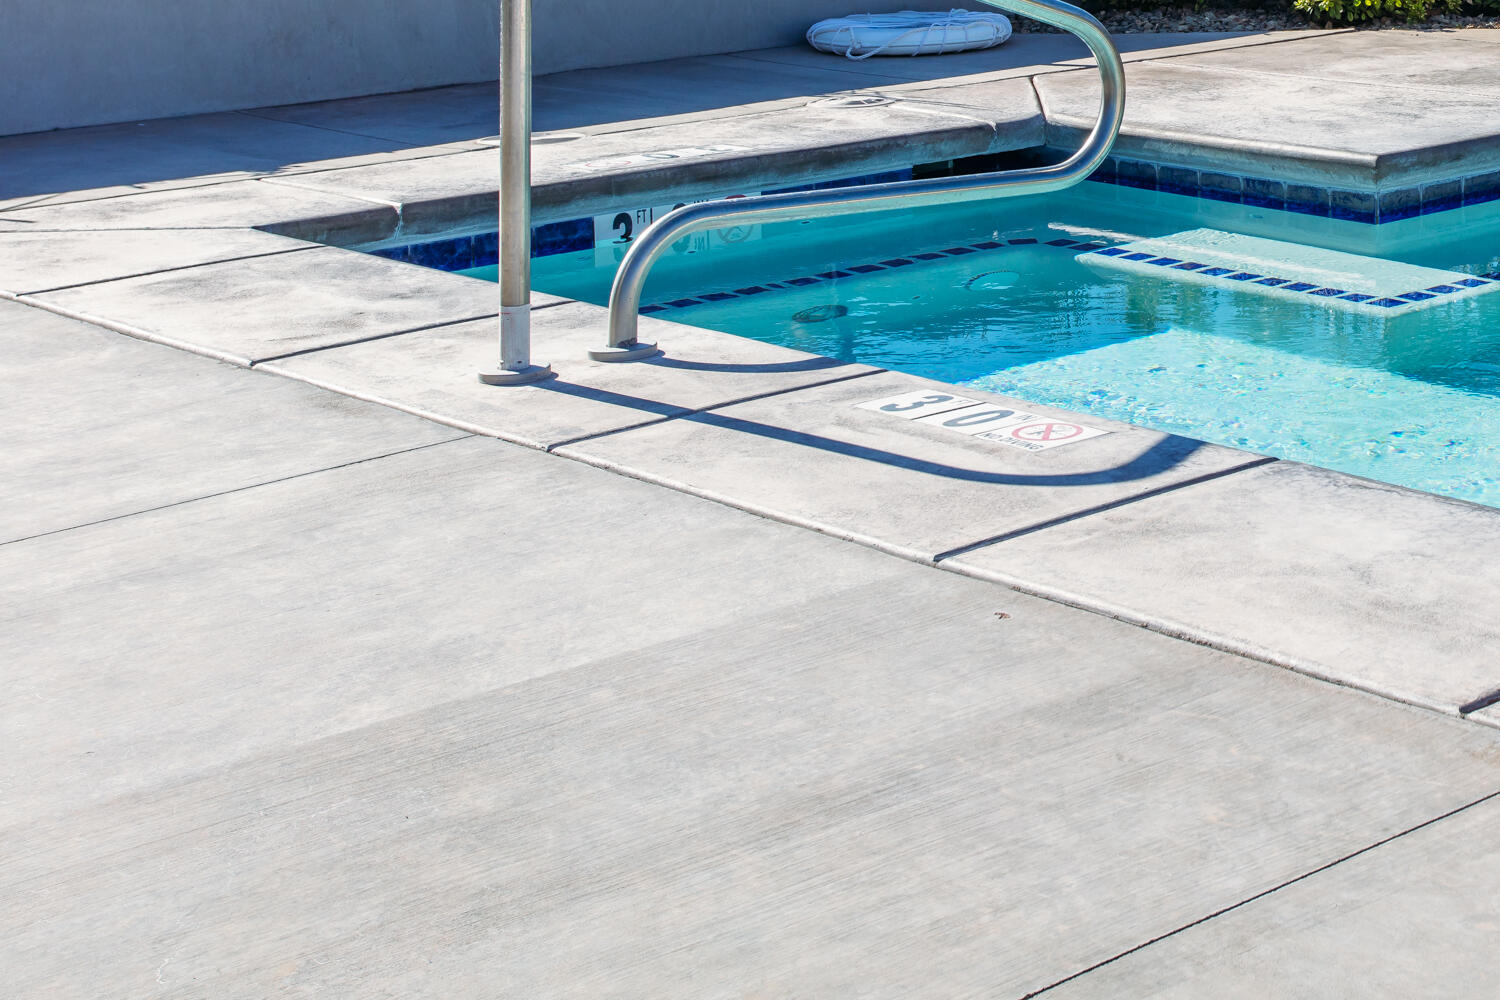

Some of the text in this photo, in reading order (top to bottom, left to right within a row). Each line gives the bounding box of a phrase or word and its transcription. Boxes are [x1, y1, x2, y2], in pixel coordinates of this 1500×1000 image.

[612, 208, 647, 244] 3 FT
[880, 395, 954, 412] 3
[942, 410, 1015, 427] 0
[999, 437, 1044, 450] DIVING
